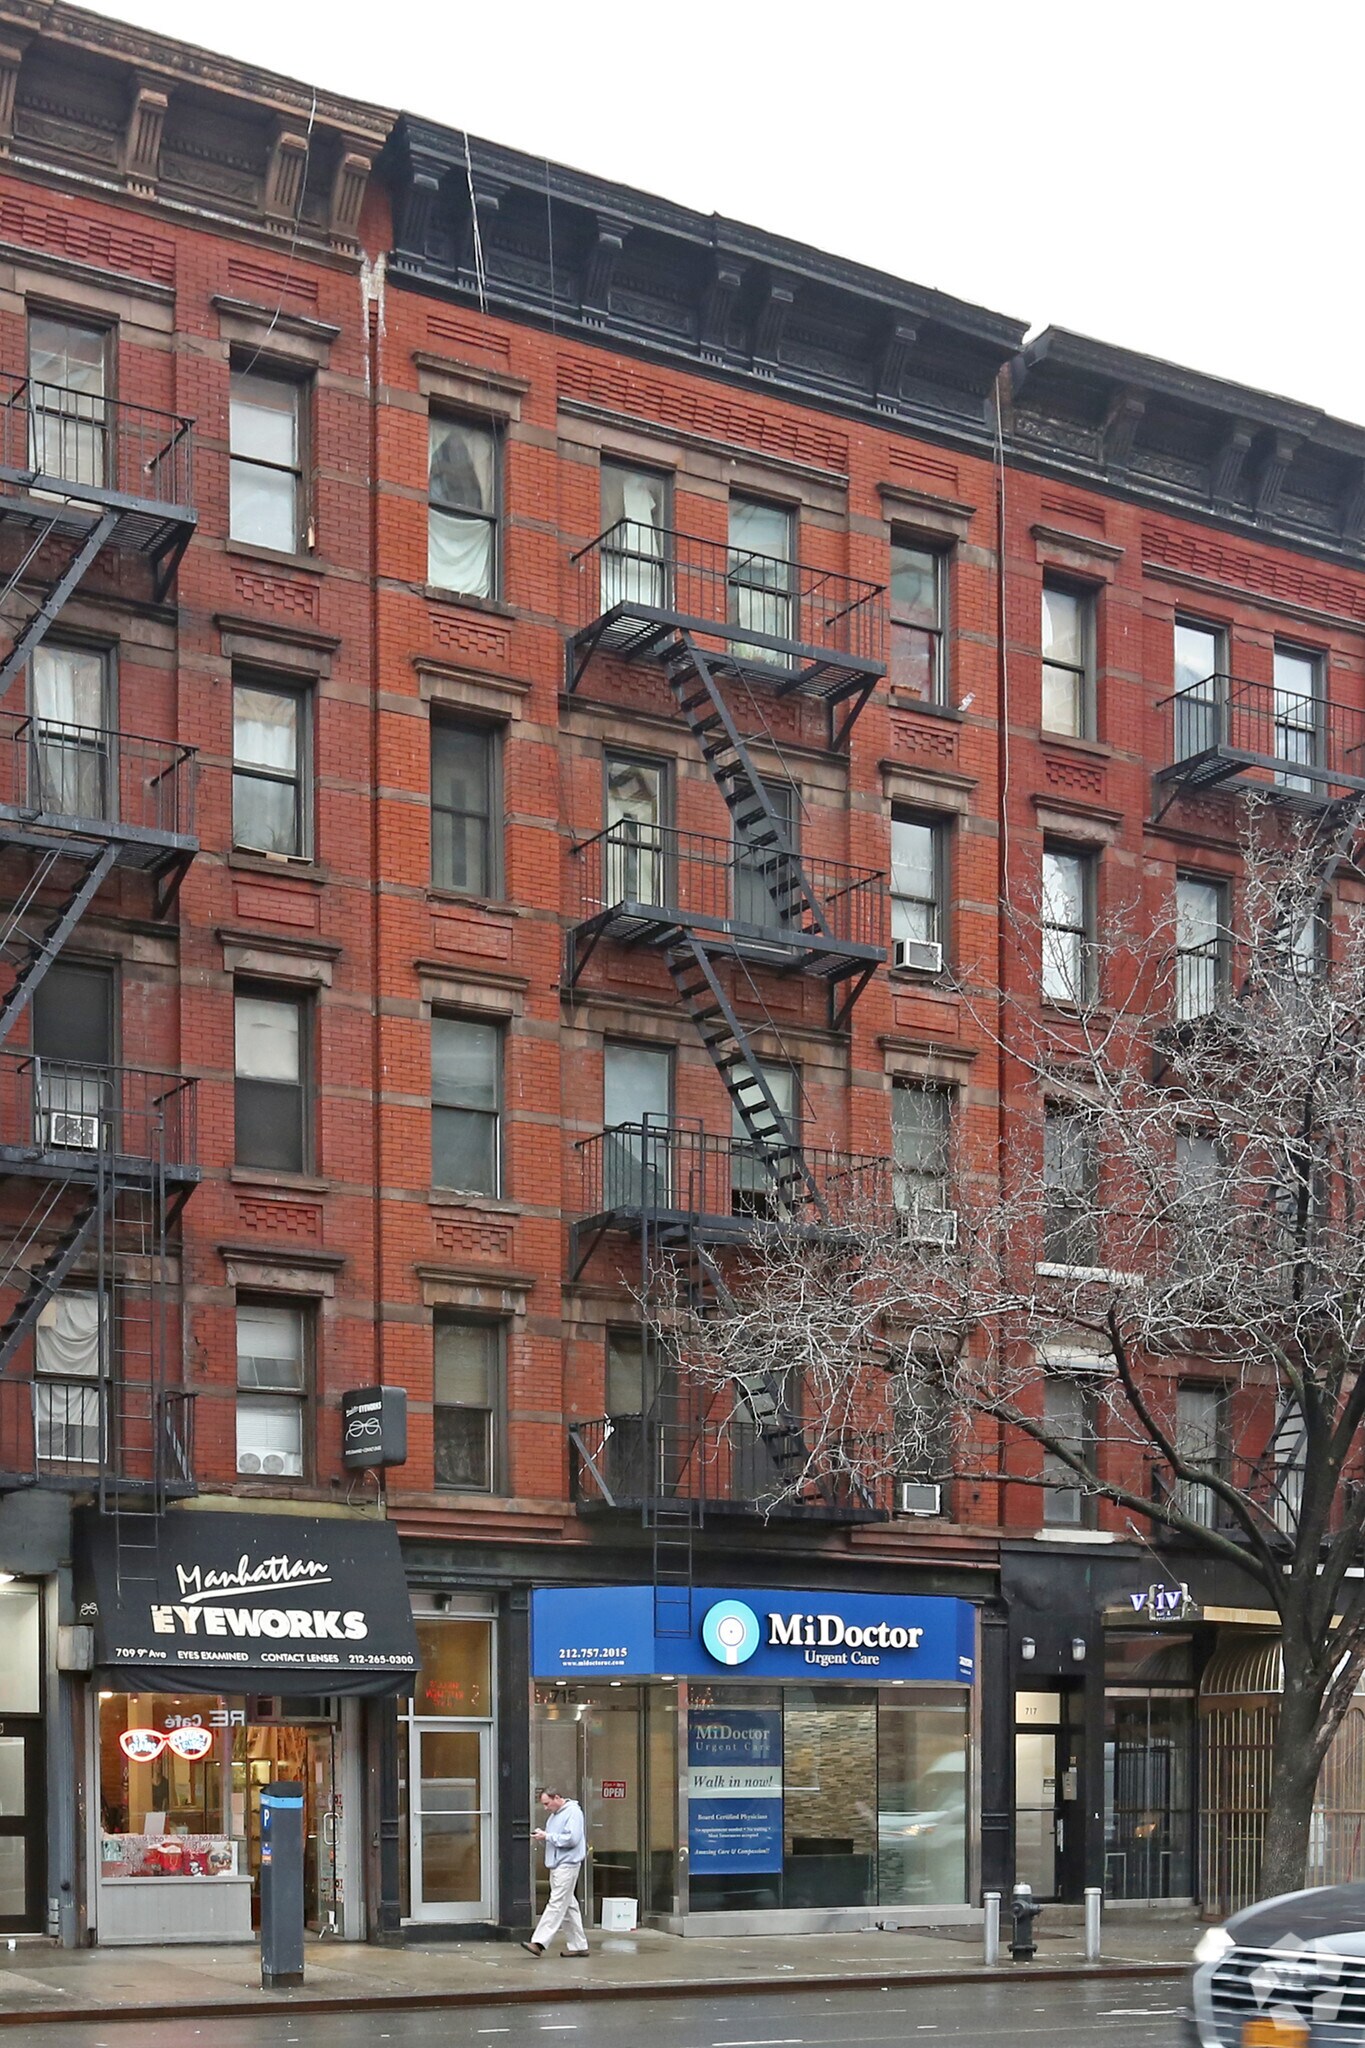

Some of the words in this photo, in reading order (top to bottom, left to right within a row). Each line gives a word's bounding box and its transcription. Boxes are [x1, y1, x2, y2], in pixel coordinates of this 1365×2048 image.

[176, 1554, 328, 1594] Manhattan
[150, 1604, 368, 1640] EYEWORKS
[768, 1613, 924, 1648] MiDoctor
[115, 1648, 135, 1658] 709
[148, 1649, 167, 1659] Ave
[177, 1650, 200, 1660] EYES
[200, 1651, 249, 1661] EXAMINED
[260, 1653, 305, 1662] CONTACT
[306, 1653, 340, 1663] LENSES
[348, 1654, 414, 1664] 212-265-0300
[559, 1647, 628, 1659] 212.757.2015
[804, 1650, 848, 1667] Urgent
[850, 1651, 880, 1666] Care
[1025, 1707, 1038, 1715] 717
[696, 1725, 770, 1739] MiDoctor
[695, 1742, 737, 1752] Urgent
[744, 1743, 770, 1751] Care
[694, 1775, 724, 1787] Walk
[729, 1776, 740, 1787] in
[745, 1775, 773, 1787] now!
[603, 1788, 624, 1797] OPEN
[264, 1809, 270, 1827] P
